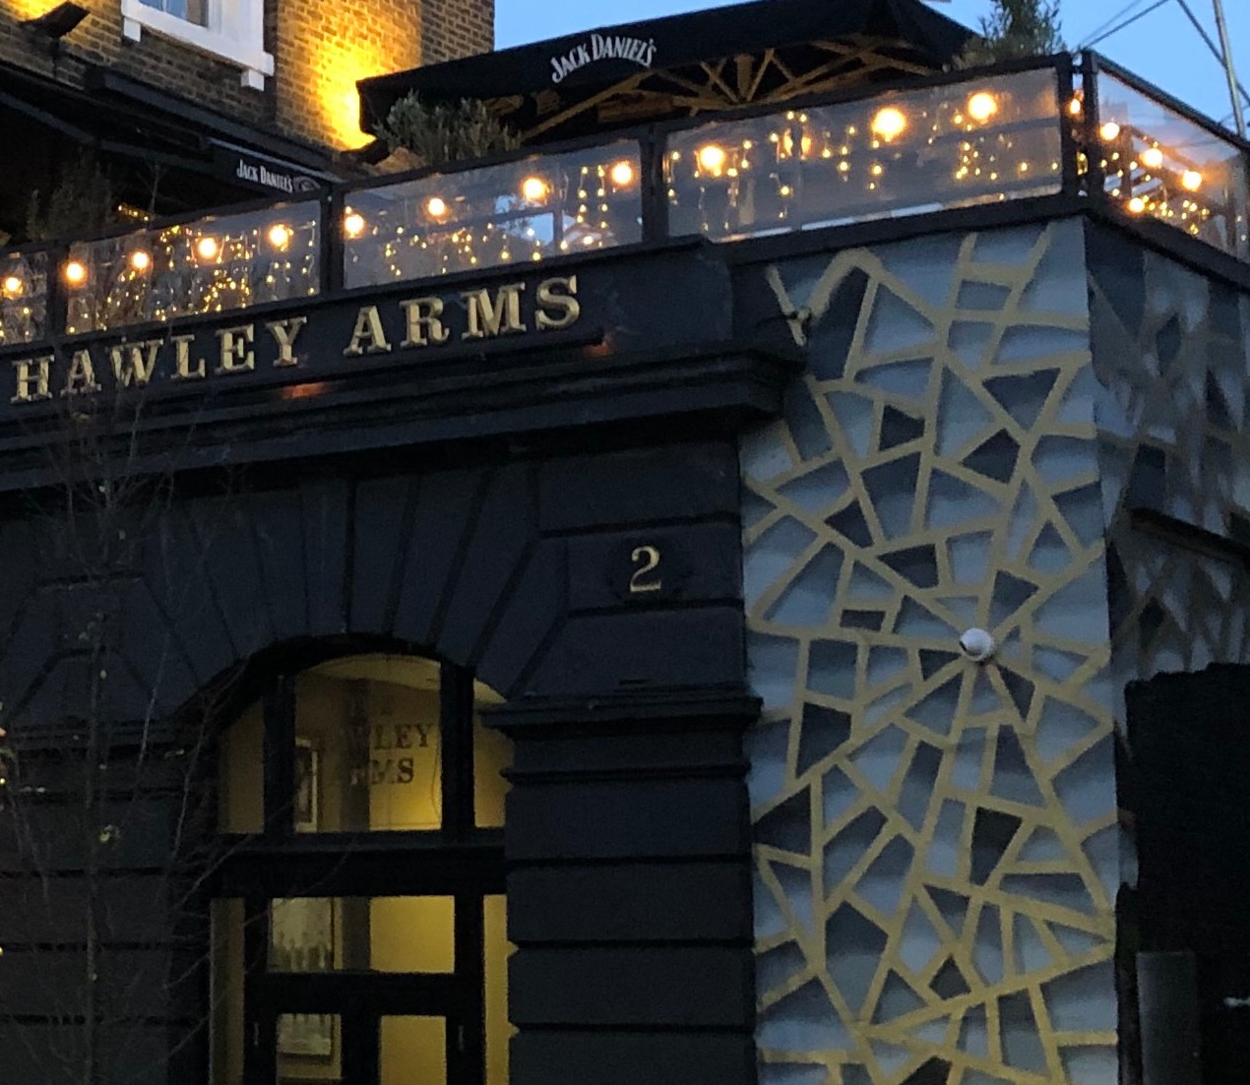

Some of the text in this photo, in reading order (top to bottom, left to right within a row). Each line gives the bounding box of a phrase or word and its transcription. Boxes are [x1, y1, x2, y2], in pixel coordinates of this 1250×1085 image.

[550, 33, 658, 84] JACK DANIEL'S
[236, 158, 293, 194] JACK DANIEL'S
[10, 316, 308, 404] HAWLEY
[342, 274, 581, 358] ARMS
[630, 545, 662, 592] 2
